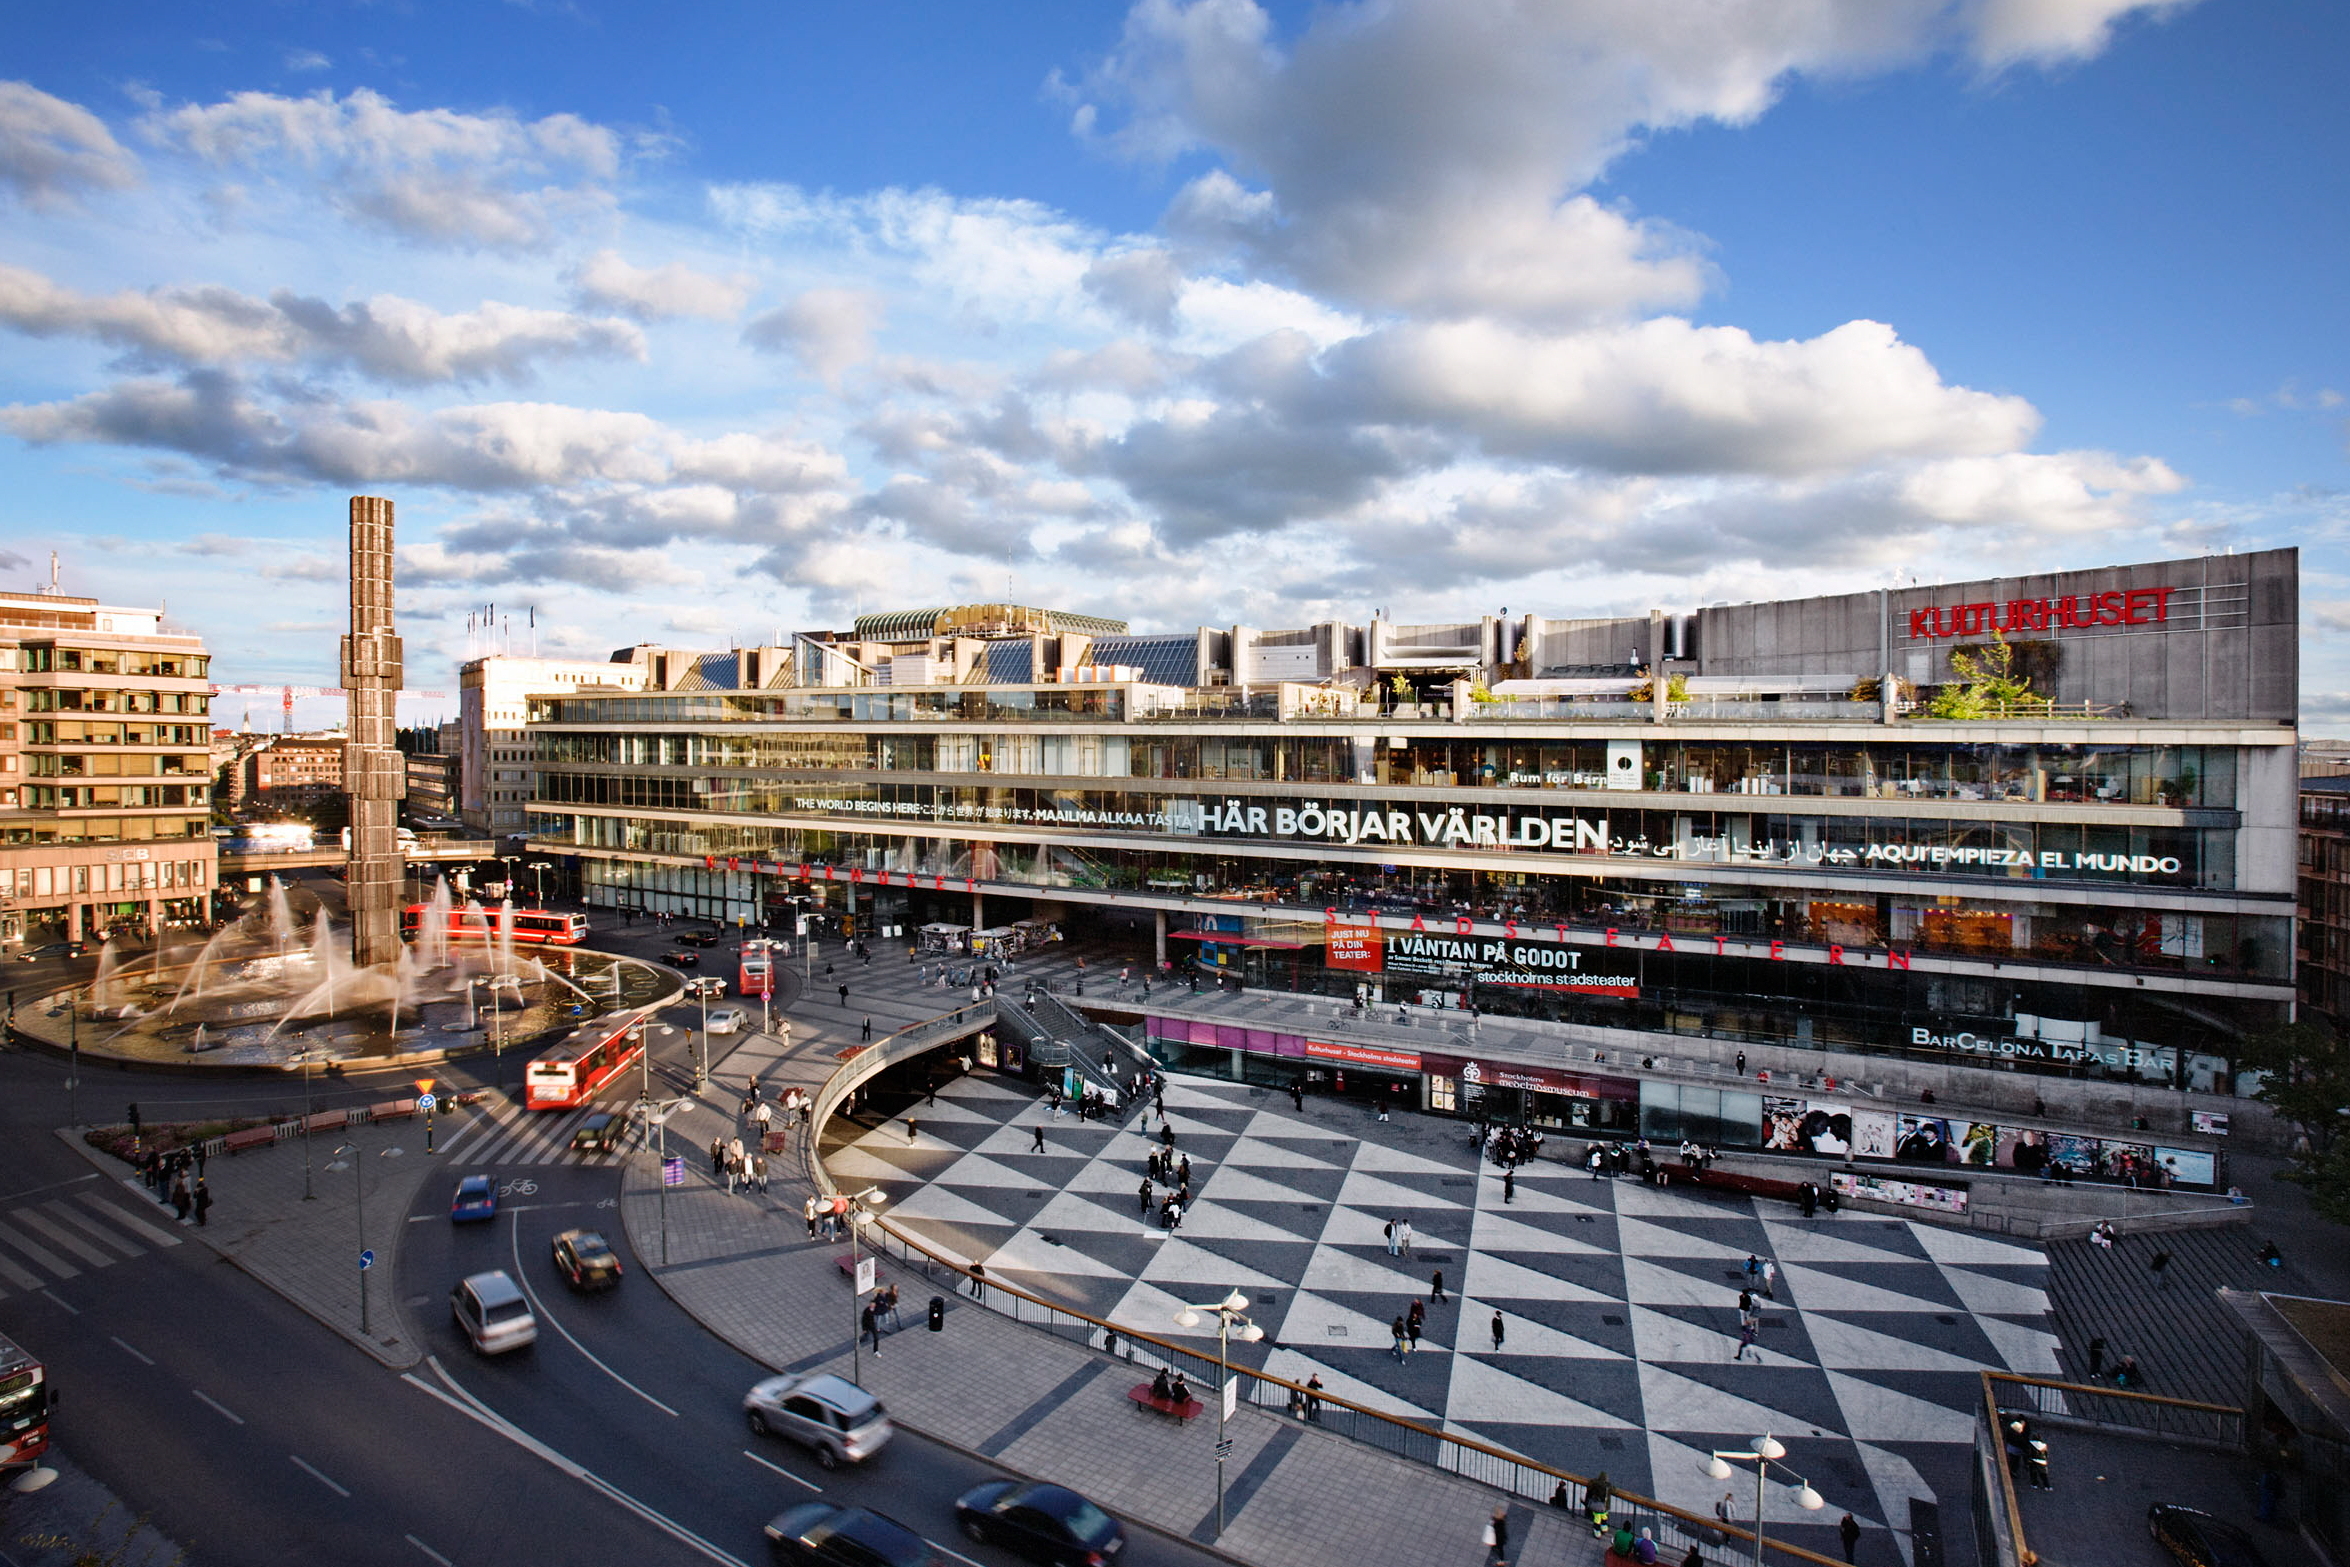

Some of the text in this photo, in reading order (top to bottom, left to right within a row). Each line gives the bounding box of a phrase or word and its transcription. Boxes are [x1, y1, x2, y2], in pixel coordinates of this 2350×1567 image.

[1910, 586, 2176, 639] KULTURHUSET
[1509, 771, 1541, 784] Rum
[1546, 771, 1568, 784] för
[1573, 773, 1608, 785] Barn
[795, 798, 920, 814] THE WORLD BEGINS HERE
[1036, 808, 1192, 827] MAAILMA ALKAA TÄSTÄ
[1198, 800, 1608, 849] HÄR BÖRJAR VÄRLDEN
[1781, 839, 1800, 861] از
[1806, 840, 1858, 864] جهان
[1932, 846, 2035, 868] EMPIEZA
[2041, 851, 2071, 869] EL
[2075, 853, 2182, 874] MUNDO
[706, 855, 976, 893] KULTURHUSET
[1331, 930, 1369, 939] JUST NU
[1332, 939, 1363, 949] PÅ DIN
[1334, 950, 1371, 959] TEATER:
[1387, 934, 1581, 970] I VÄNTAN PÅ GODOT
[1477, 970, 1635, 986] stockholms stadsteater
[1308, 1044, 1341, 1055] Kulturhuset
[1347, 1049, 1382, 1061] Stockholms
[1383, 1056, 1418, 1065] stadsteater
[1499, 1072, 1544, 1083] Stockholms
